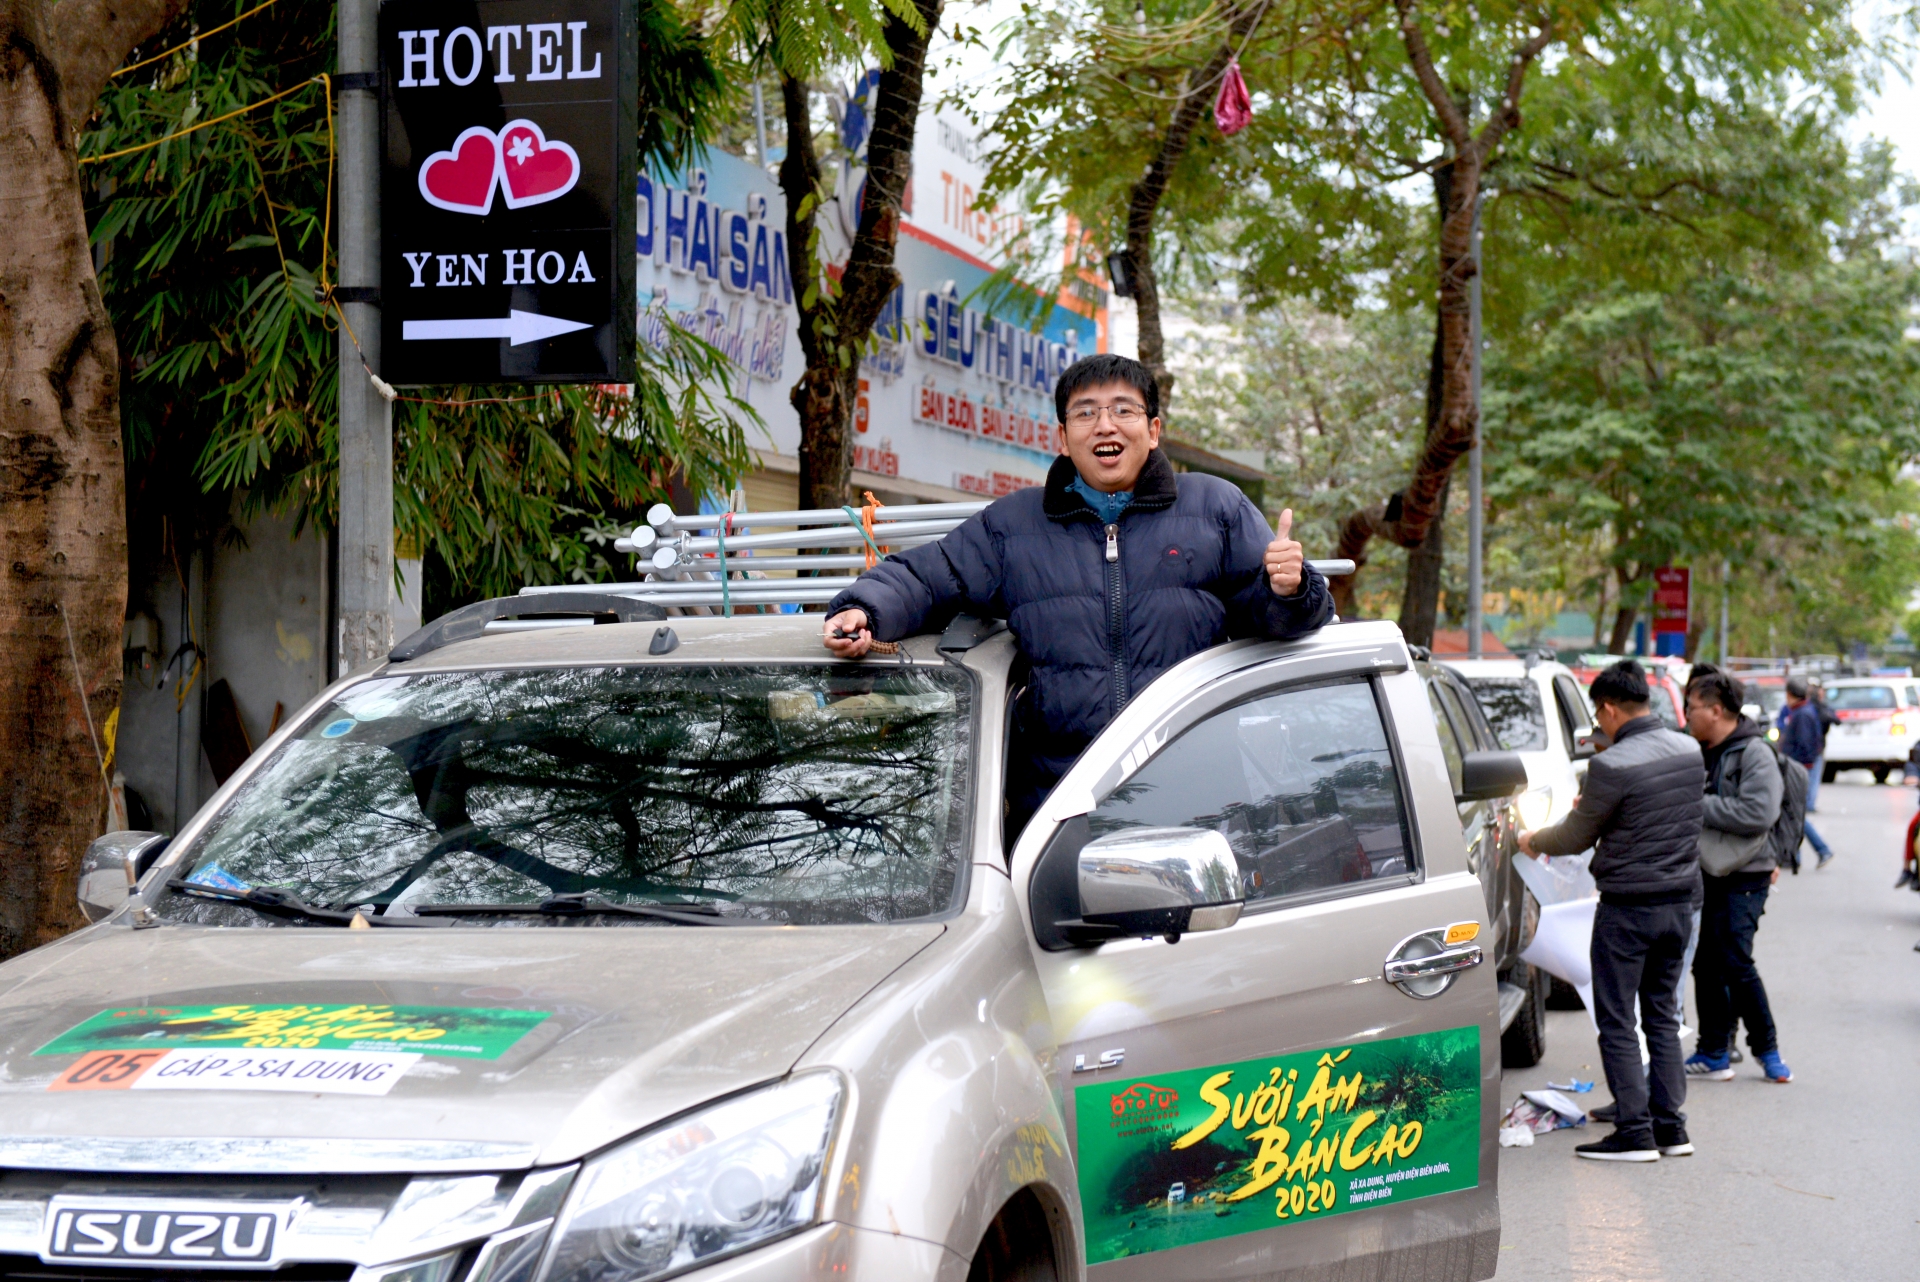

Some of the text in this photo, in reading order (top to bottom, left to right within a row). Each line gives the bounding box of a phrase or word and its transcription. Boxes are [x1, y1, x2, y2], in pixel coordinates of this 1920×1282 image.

[398, 21, 601, 87] HOTEL
[665, 172, 720, 280] HẢI
[727, 196, 793, 305] SẢN
[403, 249, 596, 287] YEN HOA
[242, 1036, 320, 1048] 2020
[1073, 1048, 1125, 1072] LS
[66, 1053, 161, 1084] 05
[218, 1059, 253, 1078] 2
[249, 1059, 296, 1078] SA
[291, 1060, 394, 1082] DUNG
[1296, 1049, 1363, 1123] ẤM
[1227, 1110, 1422, 1202] BẢN CAO
[1275, 1178, 1336, 1219] 2020
[53, 1212, 272, 1258] ISUZU
